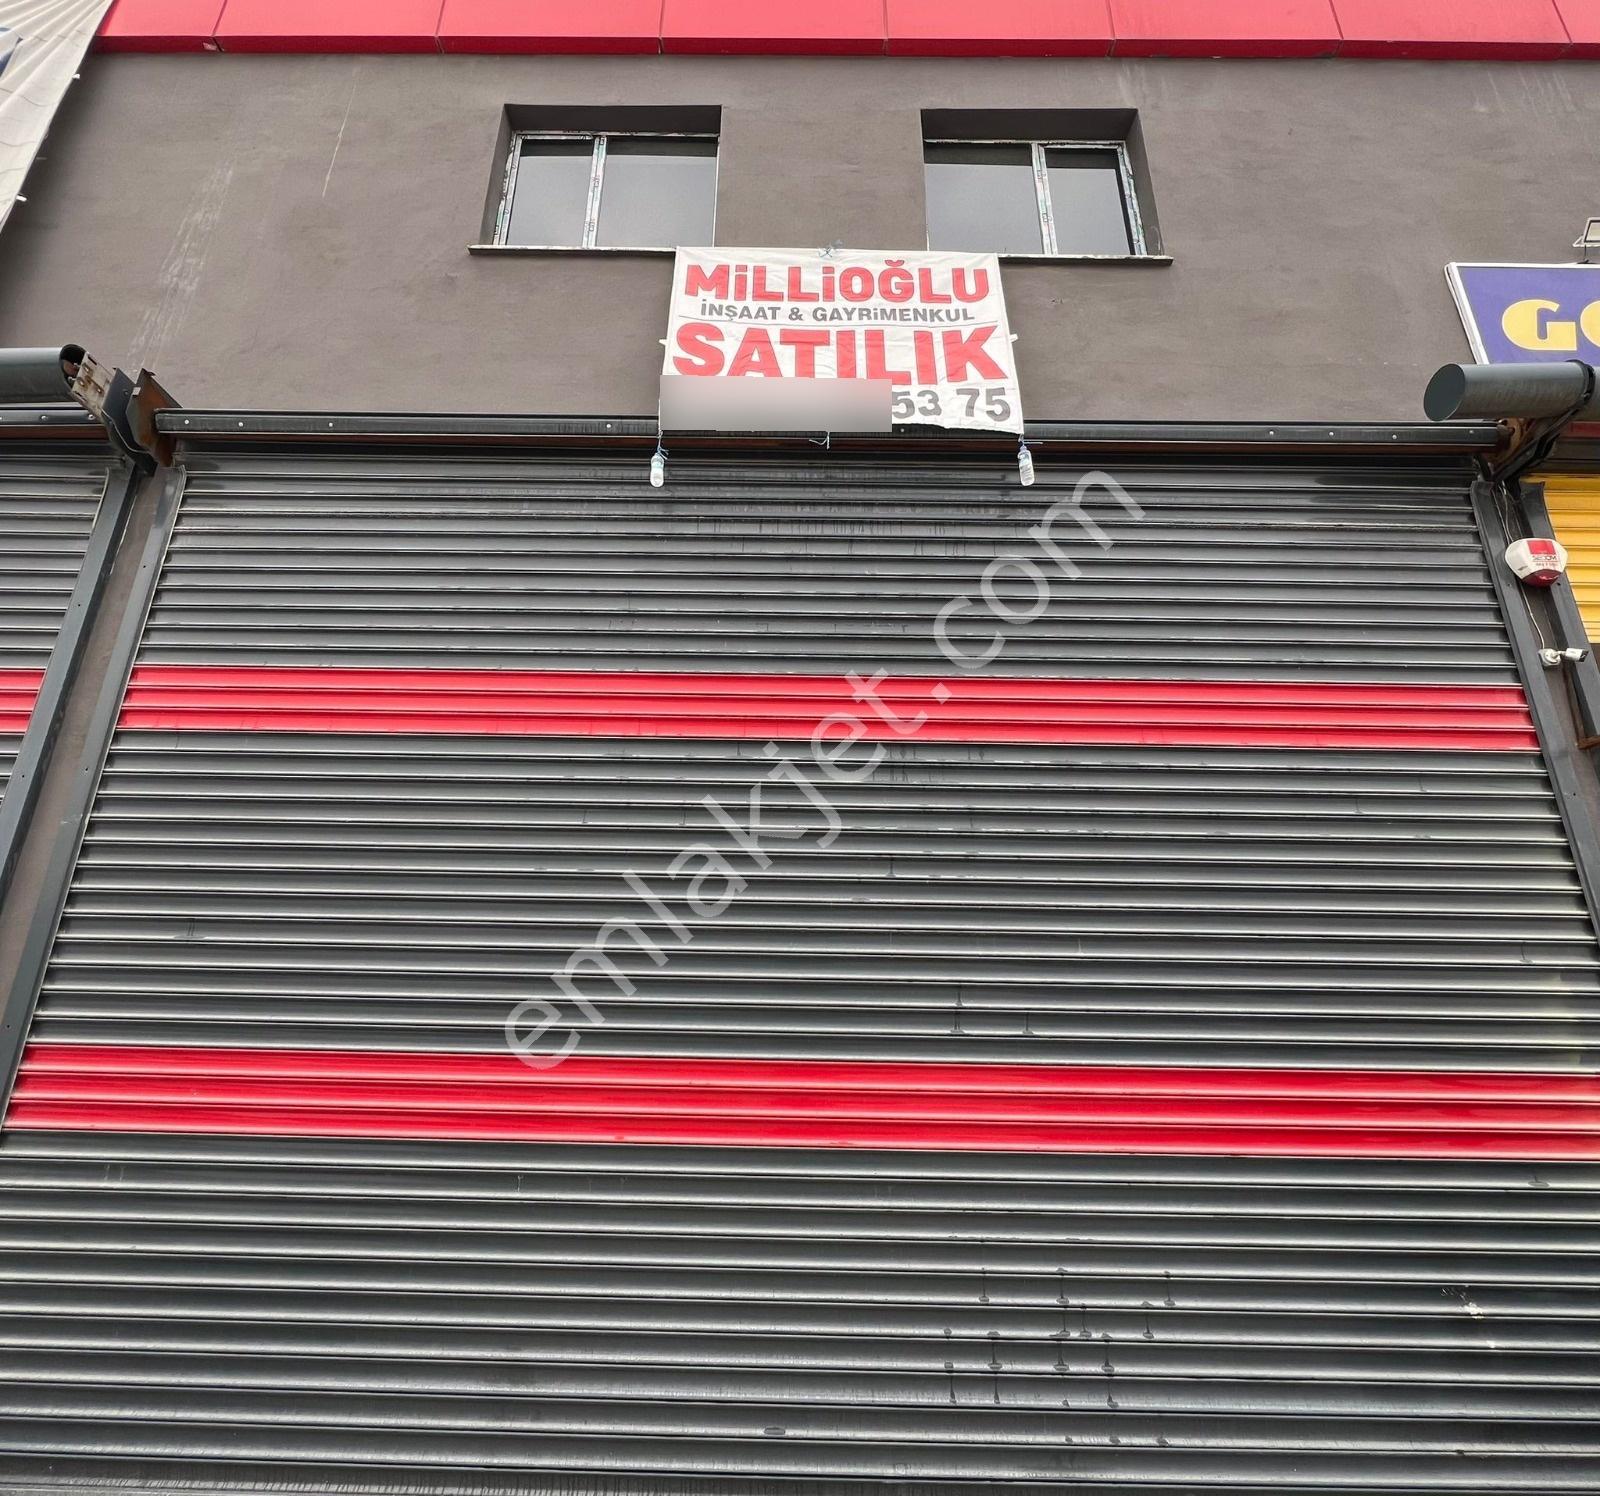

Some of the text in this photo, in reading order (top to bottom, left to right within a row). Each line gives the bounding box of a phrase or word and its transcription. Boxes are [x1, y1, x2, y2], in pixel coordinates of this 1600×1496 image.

[788, 307, 804, 321] &
[1501, 299, 1600, 351] G
[673, 322, 1008, 385] SATILIK
[892, 387, 1011, 422] 53 75
